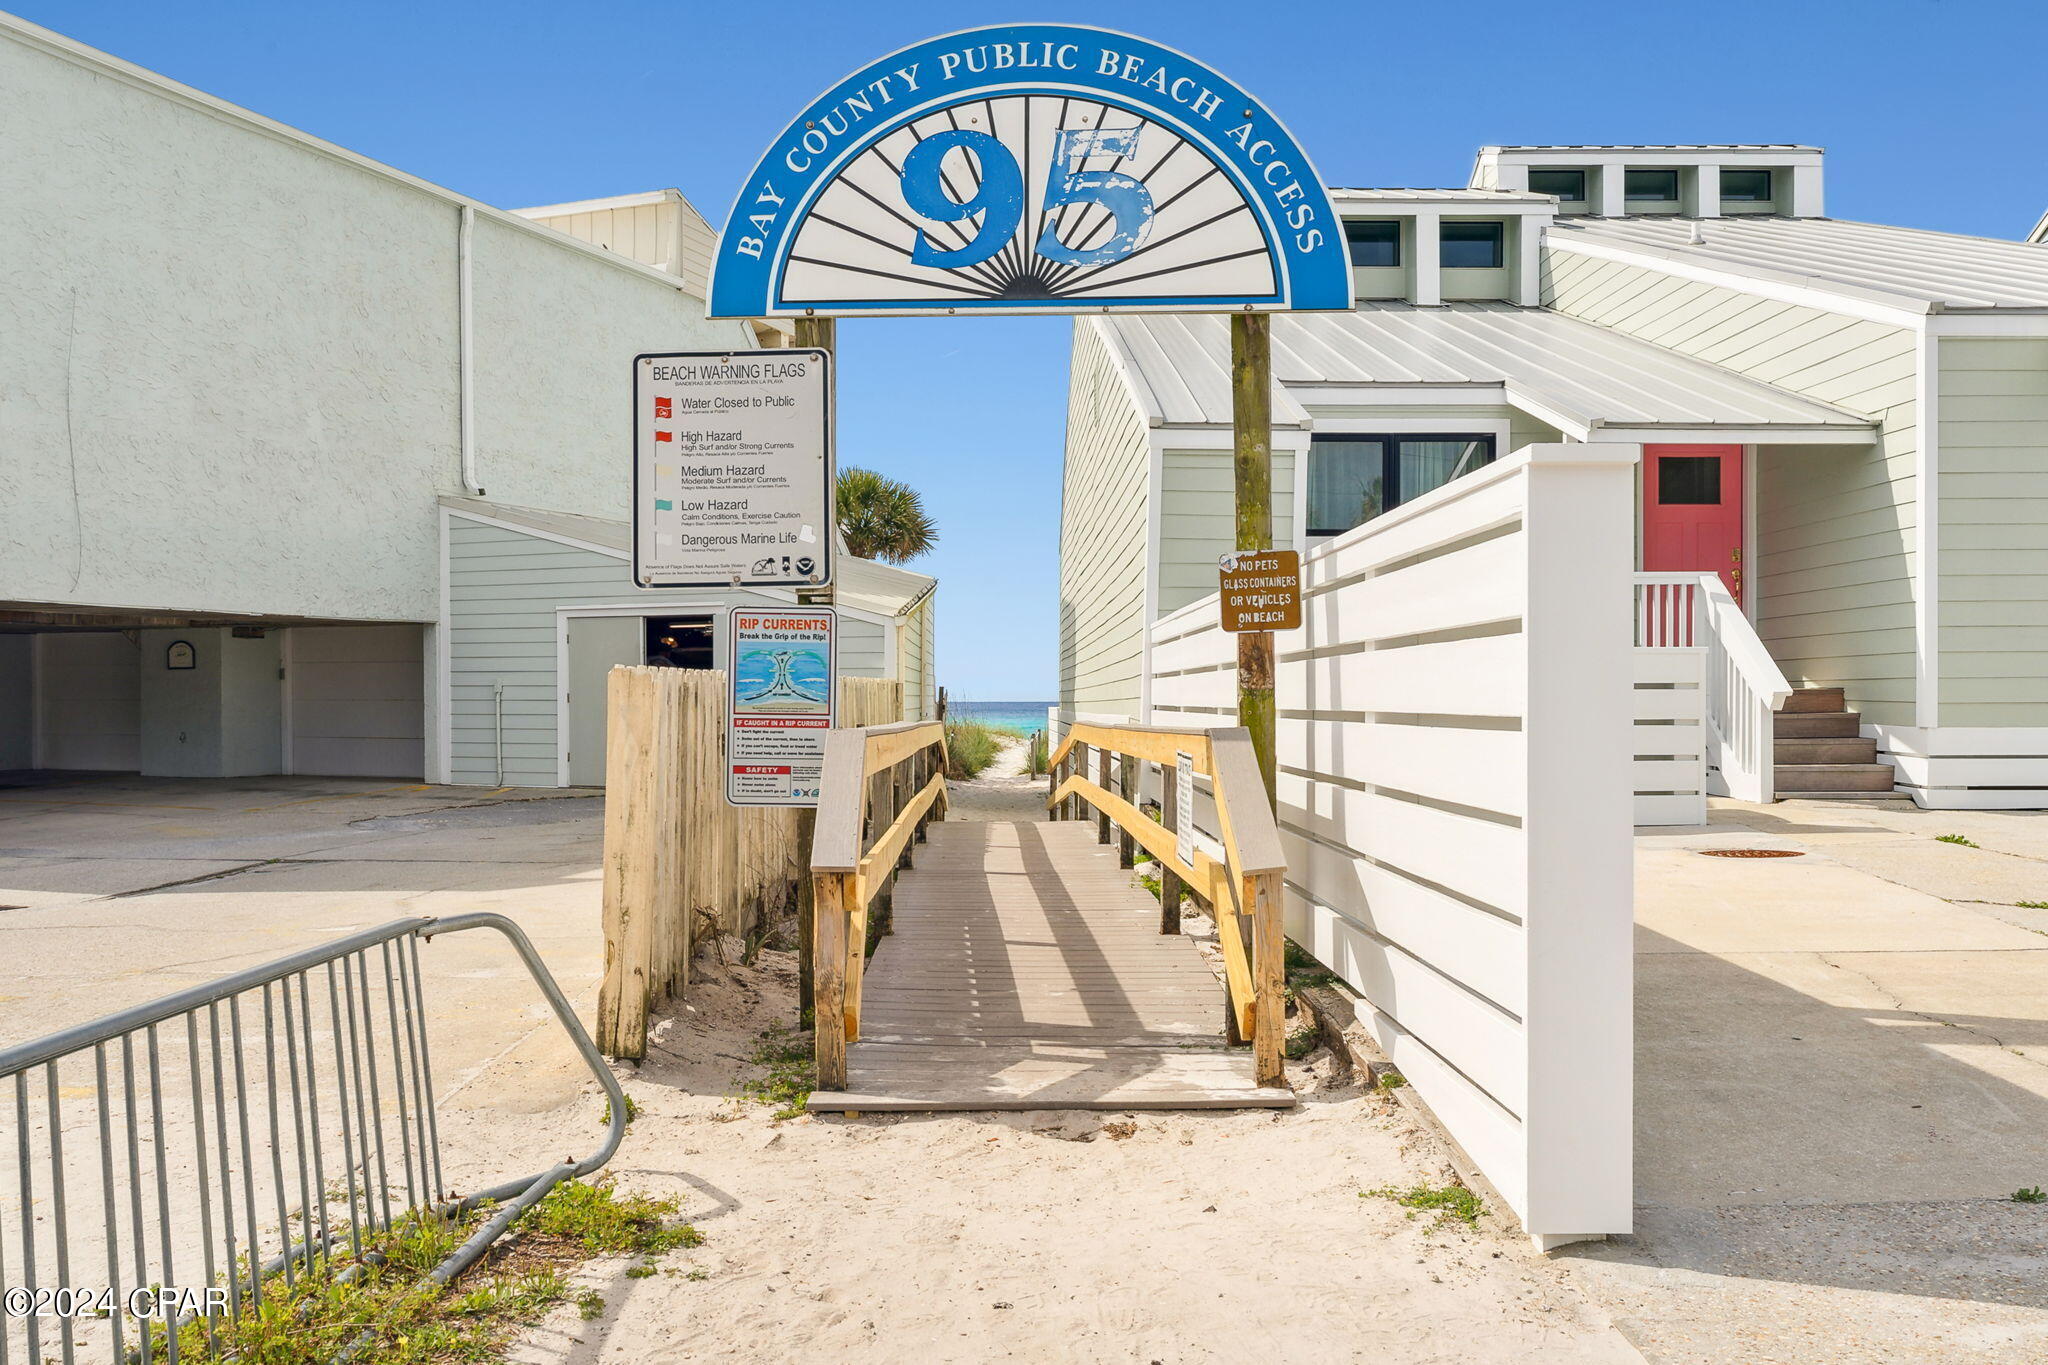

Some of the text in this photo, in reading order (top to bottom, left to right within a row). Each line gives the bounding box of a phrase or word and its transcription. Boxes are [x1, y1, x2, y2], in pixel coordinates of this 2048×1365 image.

[736, 41, 1324, 261] BAY COUNTY PUBLIC BEACH ACCESS
[901, 125, 1154, 268] 95
[653, 363, 806, 381] BEACH WARNING FLAGS
[681, 395, 795, 409] Water Closed to Public
[681, 430, 742, 445] High Hazard
[681, 444, 697, 452] High
[699, 443, 714, 451] Surf
[739, 442, 763, 451] Strong
[681, 464, 765, 477] Medium Hazard
[681, 499, 748, 511] Low Hazard
[773, 511, 801, 519] Caution
[682, 532, 798, 547] Dangerous Marine Life
[1240, 559, 1278, 571] NO PETS
[1223, 576, 1296, 590] GLASS CONTAINERS
[1230, 594, 1291, 607] OR VEHICLES
[1238, 611, 1285, 623] ON BEACH
[739, 618, 827, 631] RIP CURRENTS
[739, 632, 760, 640] Break
[761, 632, 773, 640] the
[774, 633, 788, 641] Grip
[790, 632, 798, 640] of
[813, 633, 826, 641] Rip!
